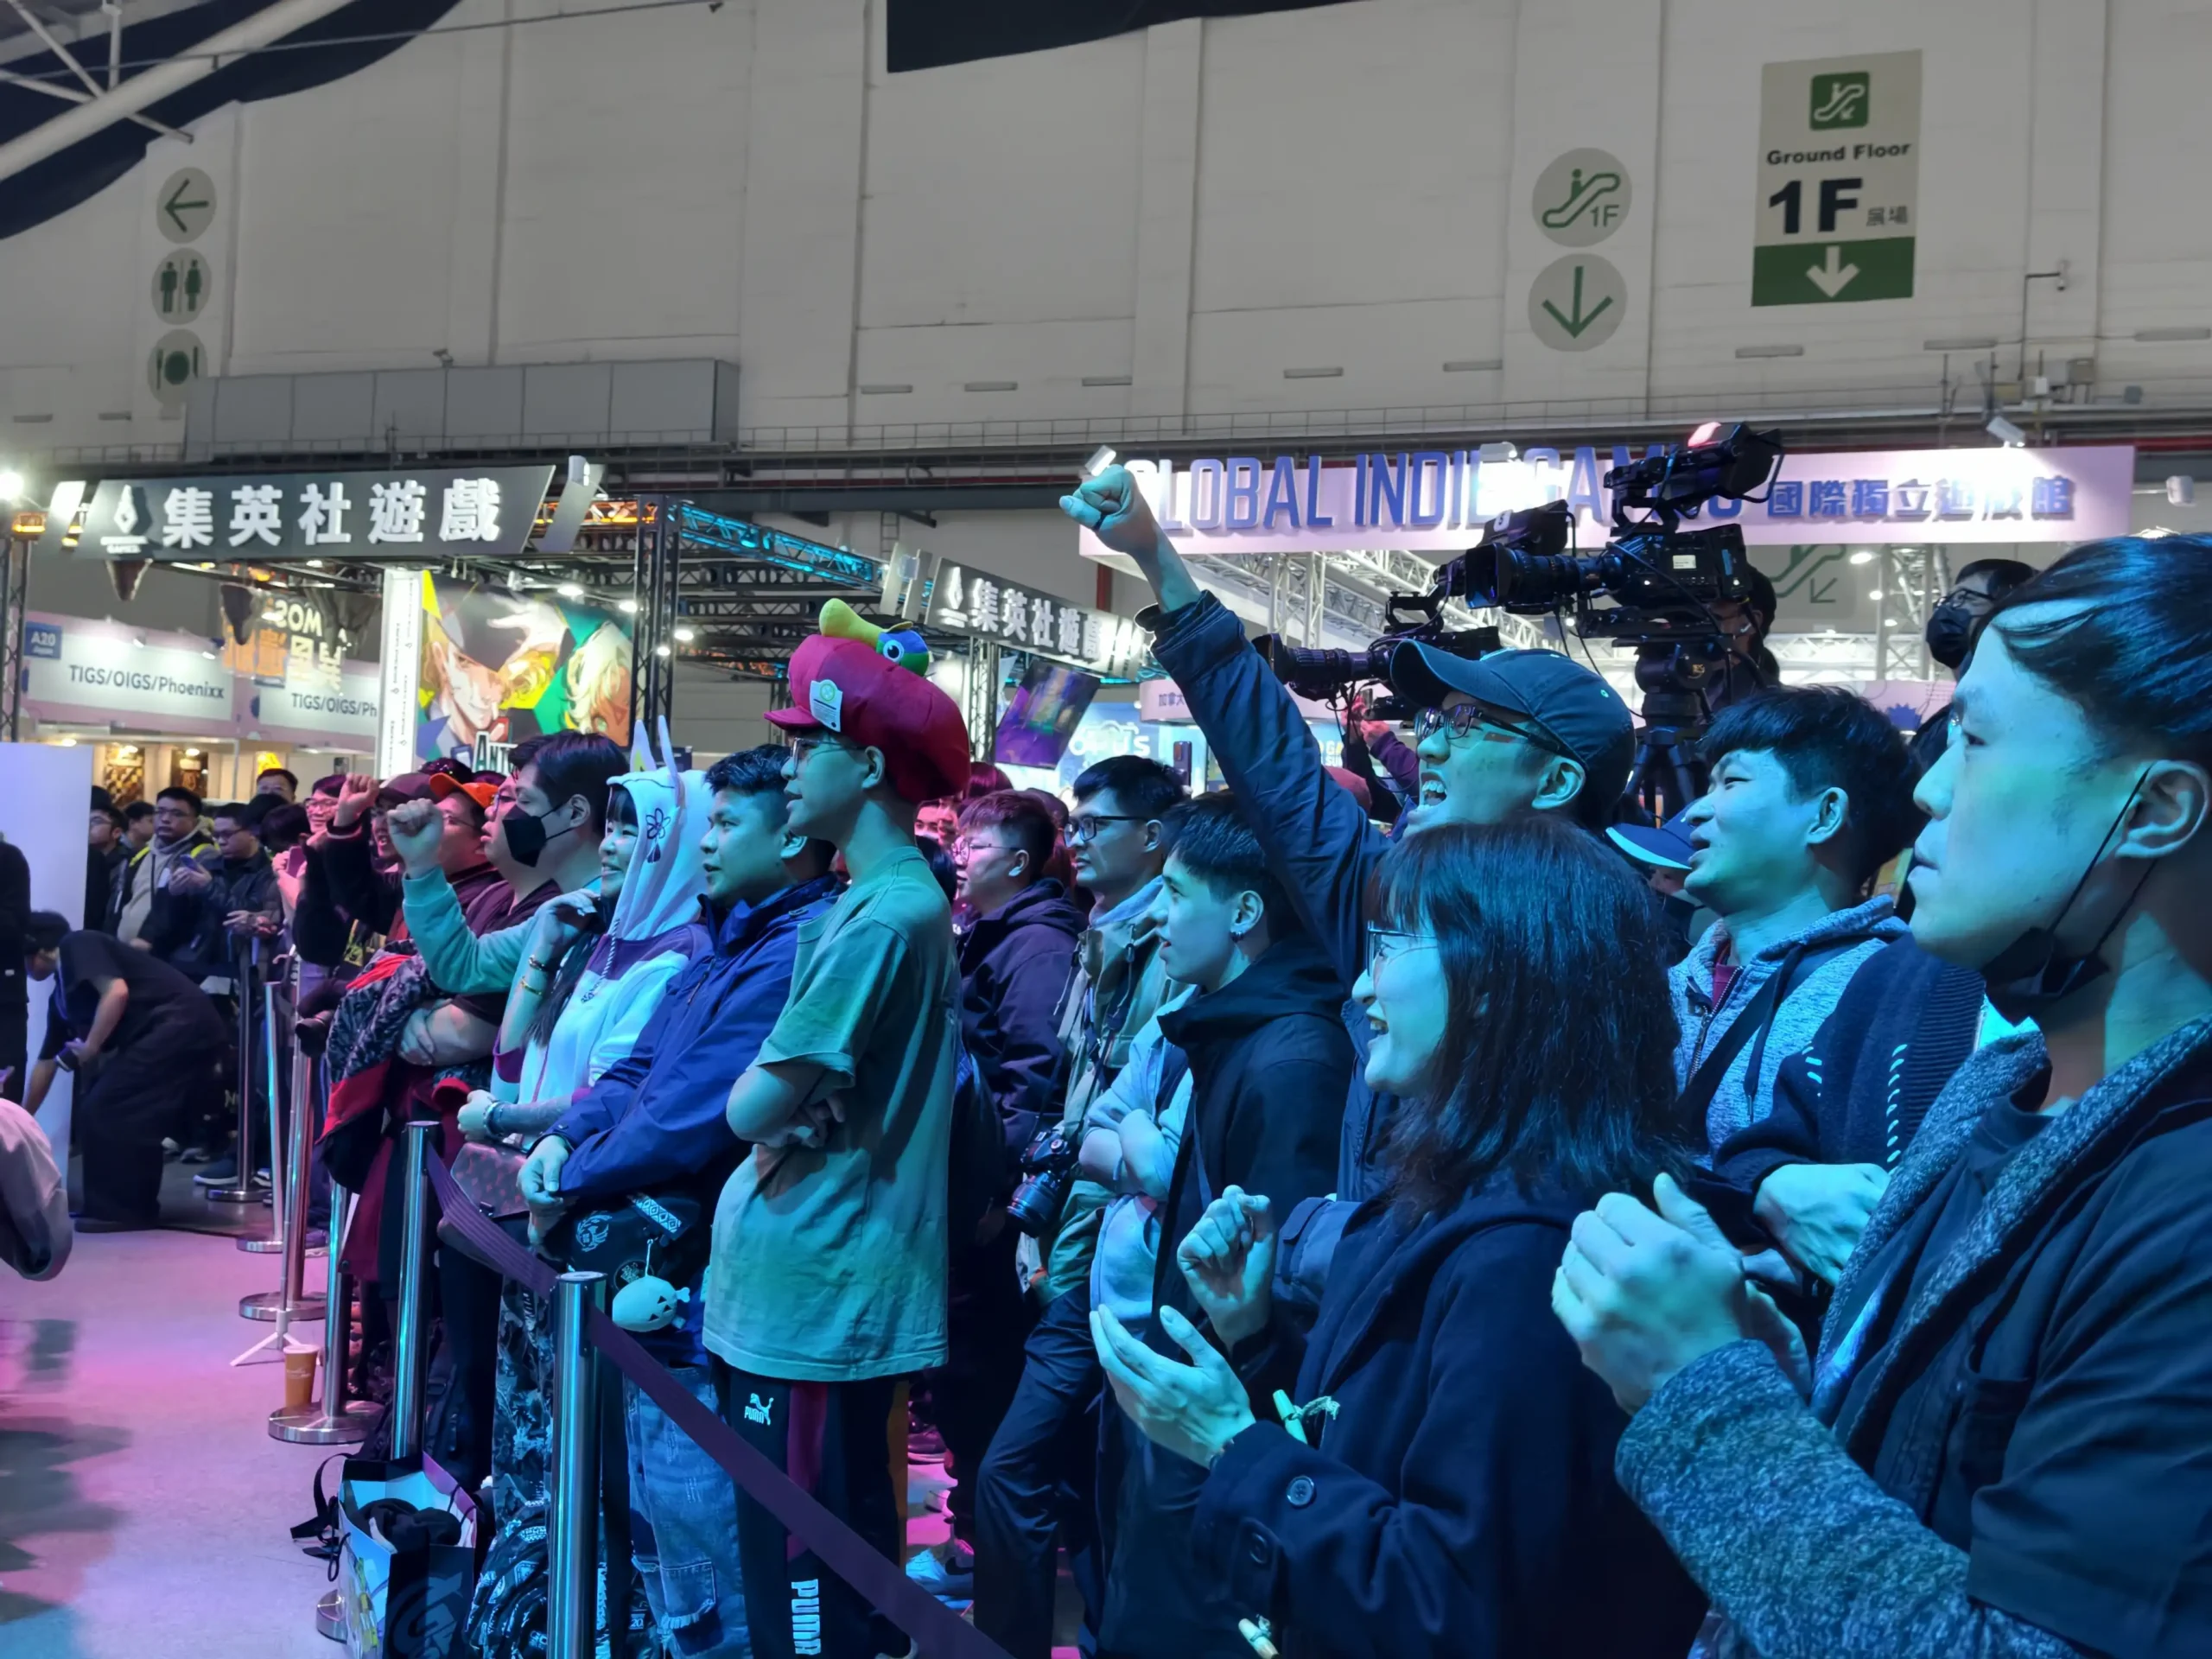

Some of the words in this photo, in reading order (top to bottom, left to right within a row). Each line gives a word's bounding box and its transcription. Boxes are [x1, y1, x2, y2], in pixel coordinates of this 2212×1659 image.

[1767, 146, 1845, 164] Ground
[1853, 143, 1910, 160] Floor
[1590, 205, 1619, 227] 1F
[1769, 178, 1863, 234] 1F
[162, 477, 501, 549] 集英社遊戲
[1124, 454, 1333, 531] LOBAL
[69, 664, 225, 699] TIGS/OIGS/Phoenixx
[791, 1579, 821, 1655] PUMA
